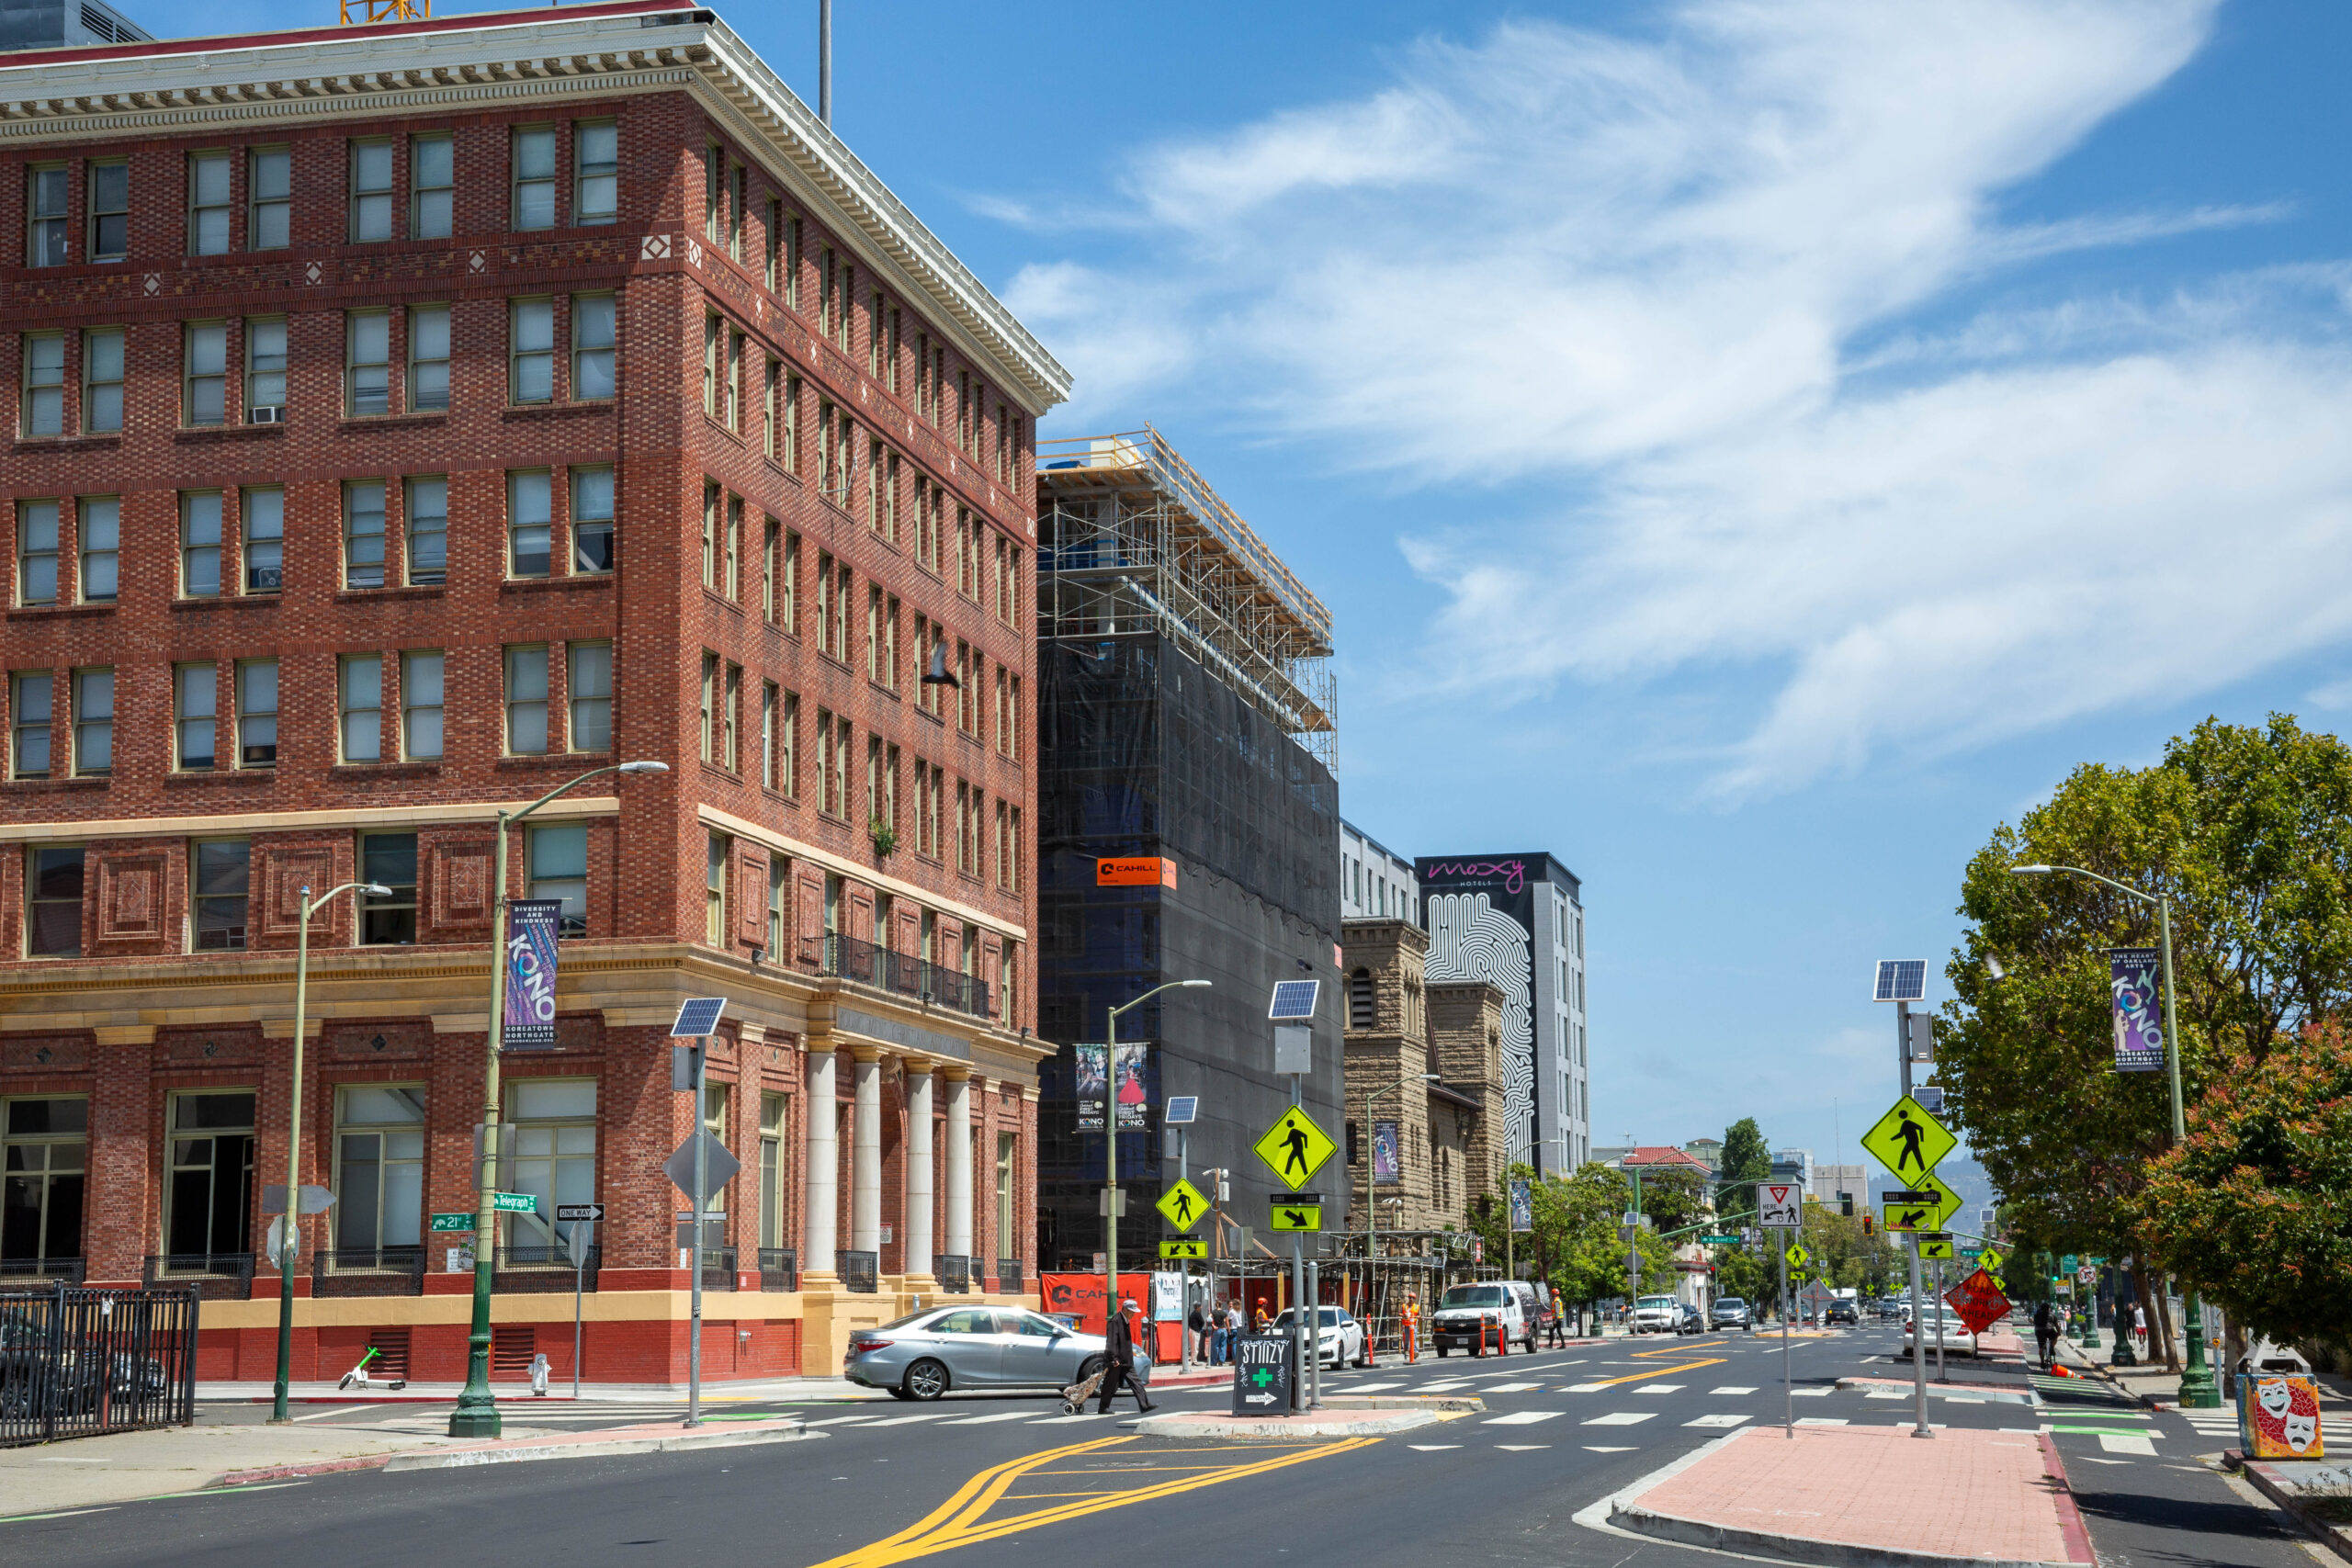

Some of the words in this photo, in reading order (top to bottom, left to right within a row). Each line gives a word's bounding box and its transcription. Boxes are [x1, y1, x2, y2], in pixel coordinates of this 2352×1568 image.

[1115, 864, 1157, 873] CAHILL
[1428, 860, 1526, 895] moxy
[508, 933, 556, 1021] KONO
[2111, 976, 2163, 1049] KONO
[1079, 1117, 1104, 1125] KONO
[1118, 1119, 1146, 1127] KONO
[1374, 1134, 1398, 1172] KONO
[499, 1195, 528, 1210] Telegraph
[1511, 1193, 1532, 1222] KONO
[560, 1209, 575, 1217] ONE
[1076, 1289, 1136, 1299] CAHLL
[1966, 1283, 1992, 1294] ROAD
[1961, 1308, 1993, 1321] AHEAD
[1242, 1344, 1285, 1364] STIIIZY
